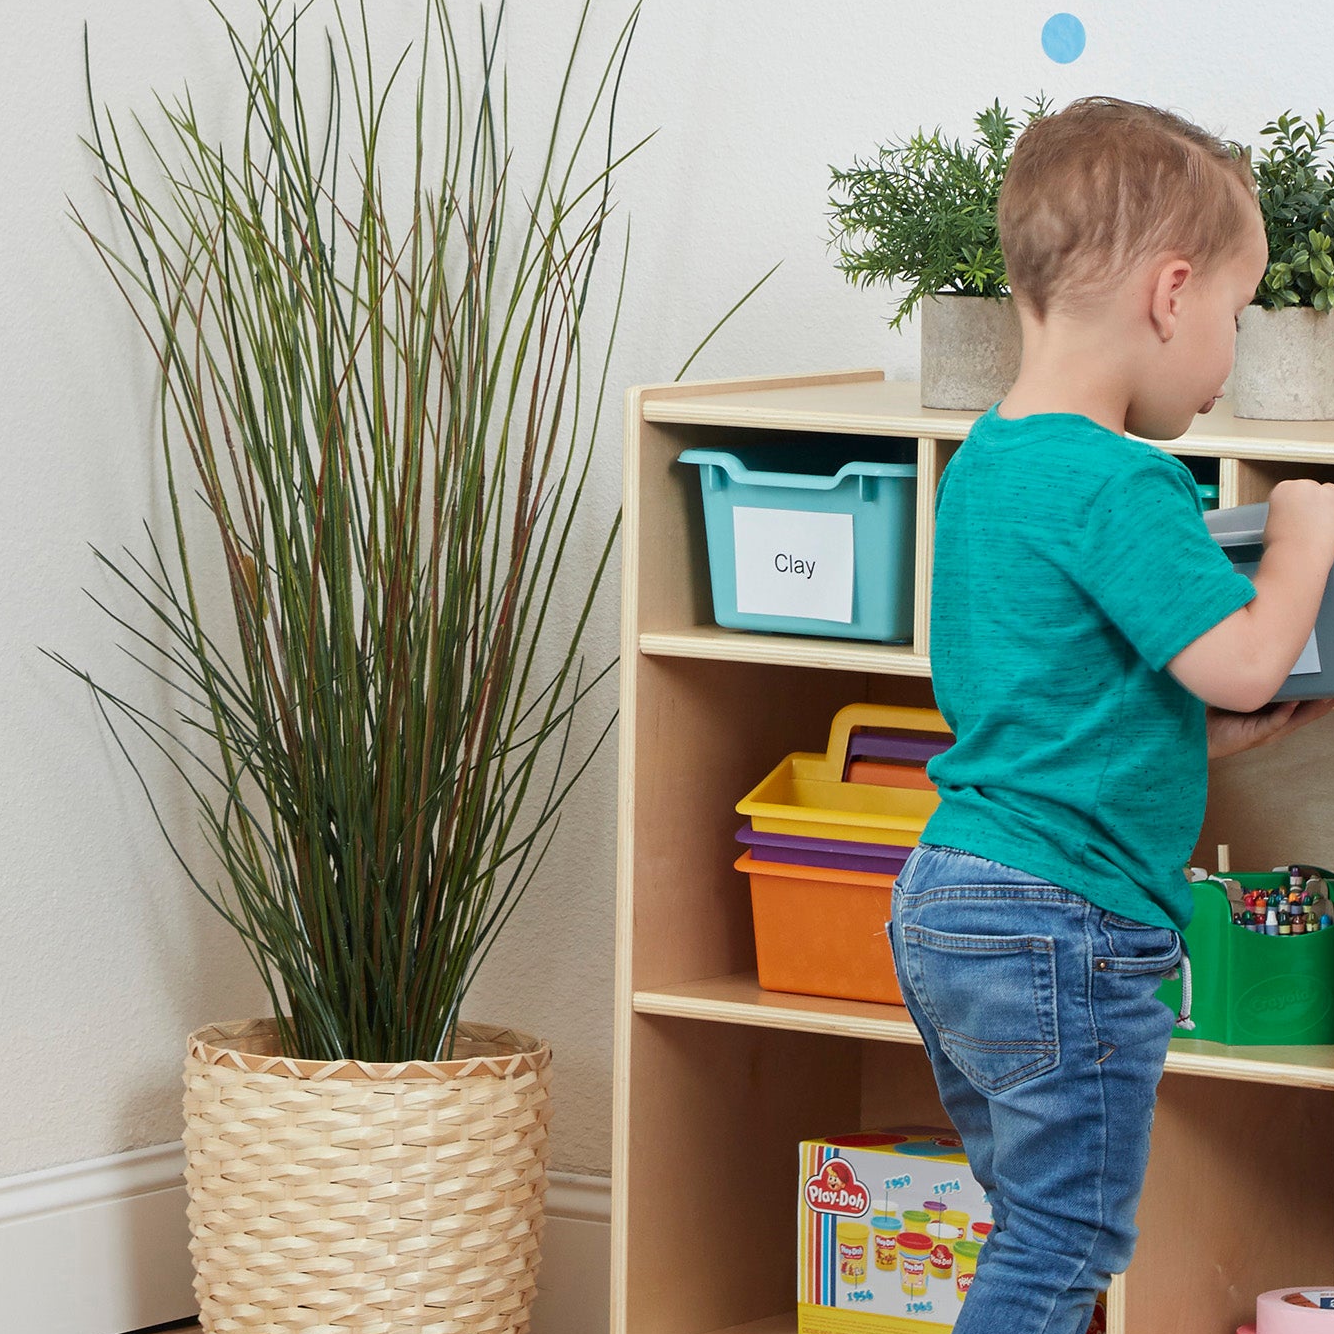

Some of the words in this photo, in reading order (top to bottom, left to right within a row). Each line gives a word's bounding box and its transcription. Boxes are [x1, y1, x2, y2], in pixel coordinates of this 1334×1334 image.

[774, 553, 816, 580] Clay
[884, 1175, 911, 1190] 1959
[808, 1185, 866, 1210] Play-Doh
